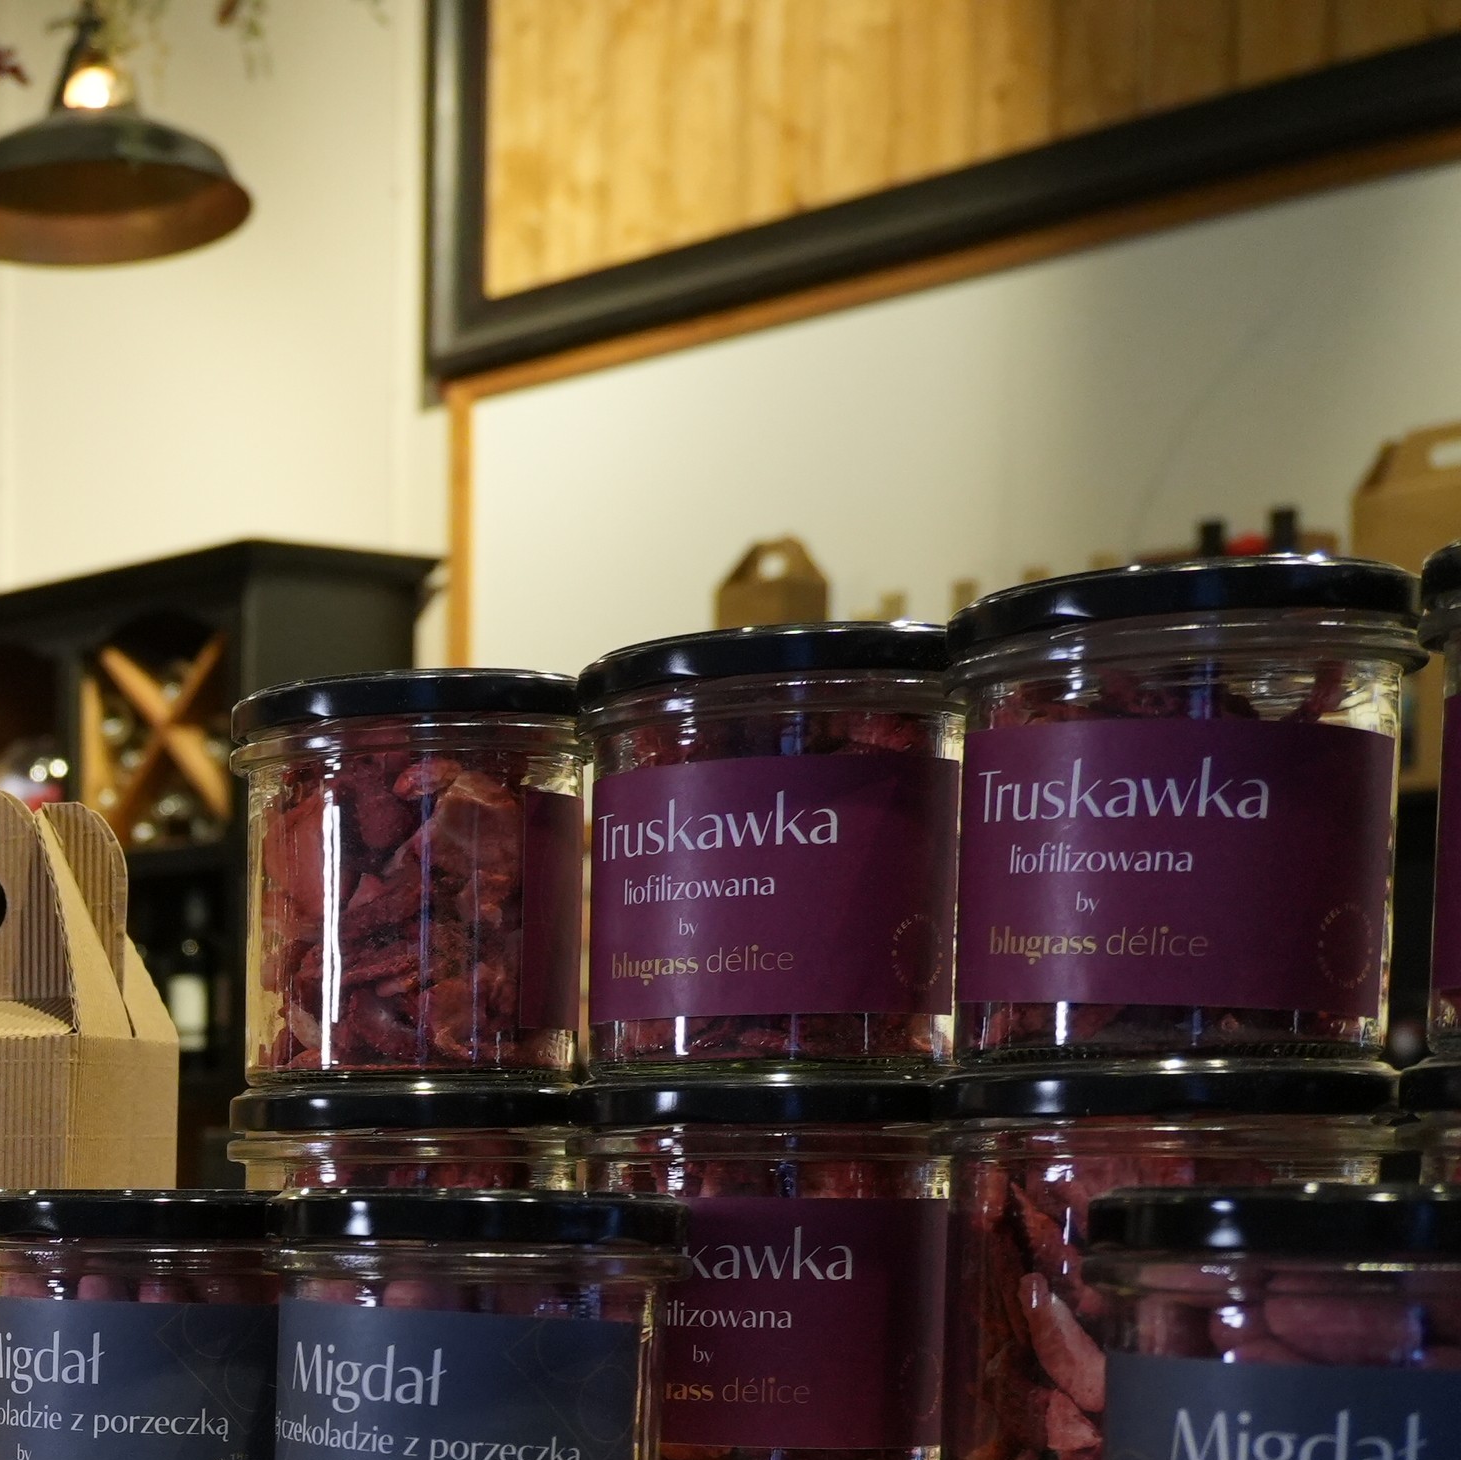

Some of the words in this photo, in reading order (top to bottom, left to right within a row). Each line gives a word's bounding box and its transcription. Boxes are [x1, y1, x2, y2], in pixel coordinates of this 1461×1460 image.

[979, 756, 1270, 824] Truskawka
[598, 789, 840, 862] Truskawka
[1009, 842, 1195, 876] liofilizowana
[624, 872, 776, 905] liofilizowana
[1076, 891, 1100, 915] by
[677, 917, 699, 940] by
[990, 925, 1097, 964] blugrass
[1106, 925, 1209, 960] délice
[611, 950, 699, 986] blugrass
[705, 944, 794, 976] délice
[682, 1226, 853, 1281] kawka
[666, 1300, 792, 1329] ilizowana
[693, 1344, 714, 1367] by
[292, 1340, 447, 1413] Migdał
[665, 1382, 715, 1401] rass
[722, 1376, 810, 1404] délice
[70, 1410, 84, 1430] z
[92, 1409, 230, 1442] porzeczką
[282, 1418, 394, 1457] czekoladzie
[403, 1435, 419, 1457] z
